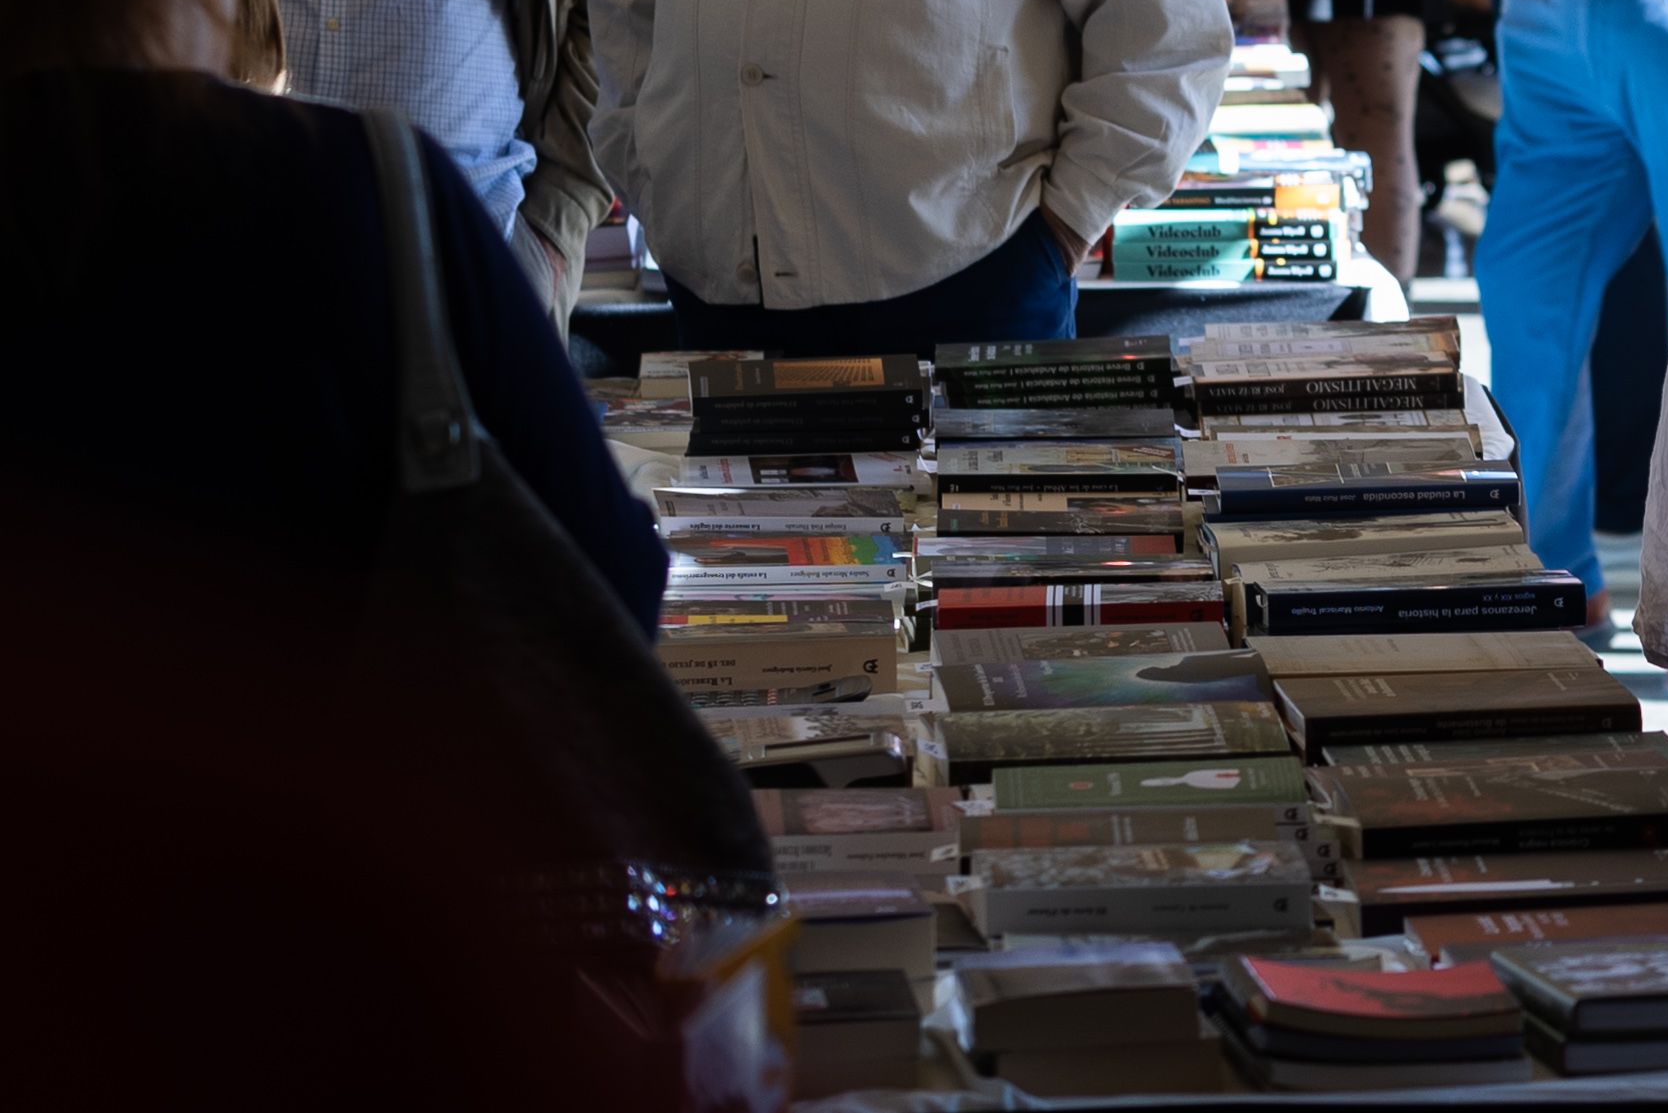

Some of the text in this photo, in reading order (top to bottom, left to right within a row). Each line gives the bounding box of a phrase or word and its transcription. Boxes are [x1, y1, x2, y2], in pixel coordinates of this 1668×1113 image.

[1147, 225, 1222, 239] Videoclub
[1145, 245, 1220, 258] Videoclub
[1146, 265, 1221, 278] Videoclub
[1059, 365, 1069, 374] de
[1072, 364, 1103, 373] Historia
[1107, 363, 1130, 371] Breve
[1069, 378, 1079, 386] de
[1082, 377, 1114, 386] Historia
[1118, 375, 1141, 384] Breve
[1305, 378, 1417, 394] MEGALITISMO
[1120, 390, 1144, 399] Breve
[1209, 387, 1236, 397] MATA
[1239, 386, 1261, 396] RUIZ
[1072, 393, 1082, 402] de
[1085, 392, 1117, 401] Historia
[1313, 396, 1424, 411] MEGALITISMO
[1363, 491, 1415, 502] escondida
[1418, 491, 1449, 500] ciudad
[1453, 490, 1465, 499] La
[1482, 594, 1492, 602] XX
[1500, 593, 1512, 602] XIX
[1515, 591, 1536, 601] siglos
[1291, 604, 1537, 620] Jerezanos para la historia Antonio Mariscal Trujillo
[669, 659, 693, 669] JULIO
[694, 660, 706, 668] DE
[720, 659, 735, 667] DEL
[796, 666, 816, 674] García
[818, 664, 832, 672] José
[673, 677, 718, 687] REBELIÓ
